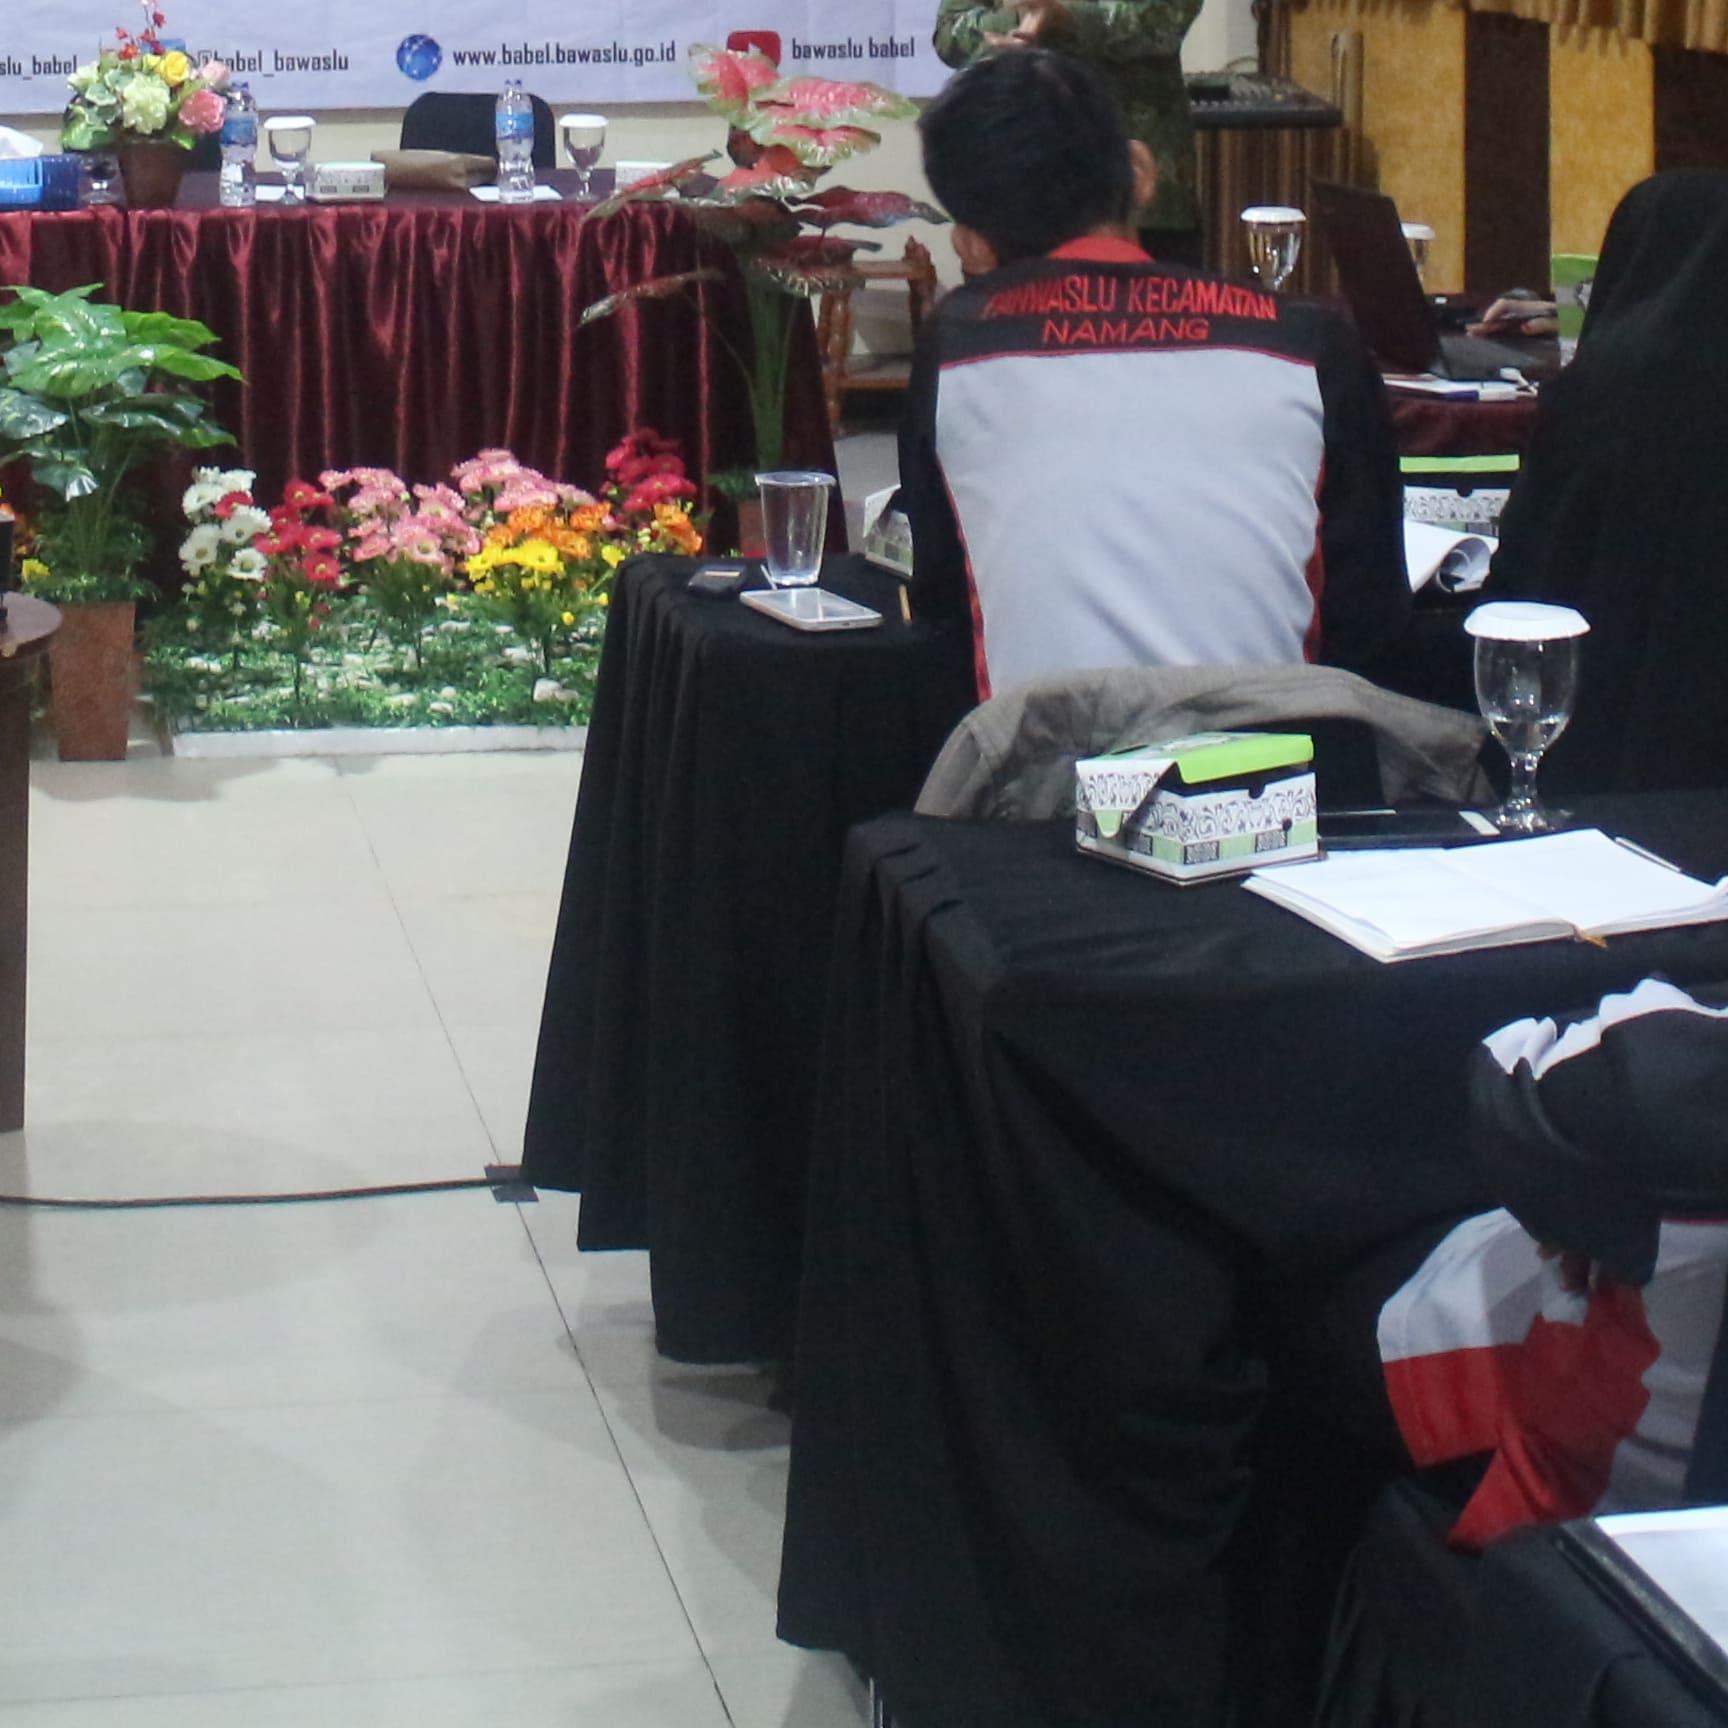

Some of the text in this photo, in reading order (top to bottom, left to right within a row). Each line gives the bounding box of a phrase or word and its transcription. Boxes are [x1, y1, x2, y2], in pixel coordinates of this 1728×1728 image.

[453, 41, 676, 67] www.babel.bawaslu.go.id
[791, 35, 916, 61] bawaslu babel
[981, 274, 1278, 321] PANWASLU KECAMATAN
[1041, 318, 1211, 344] NAMANG
